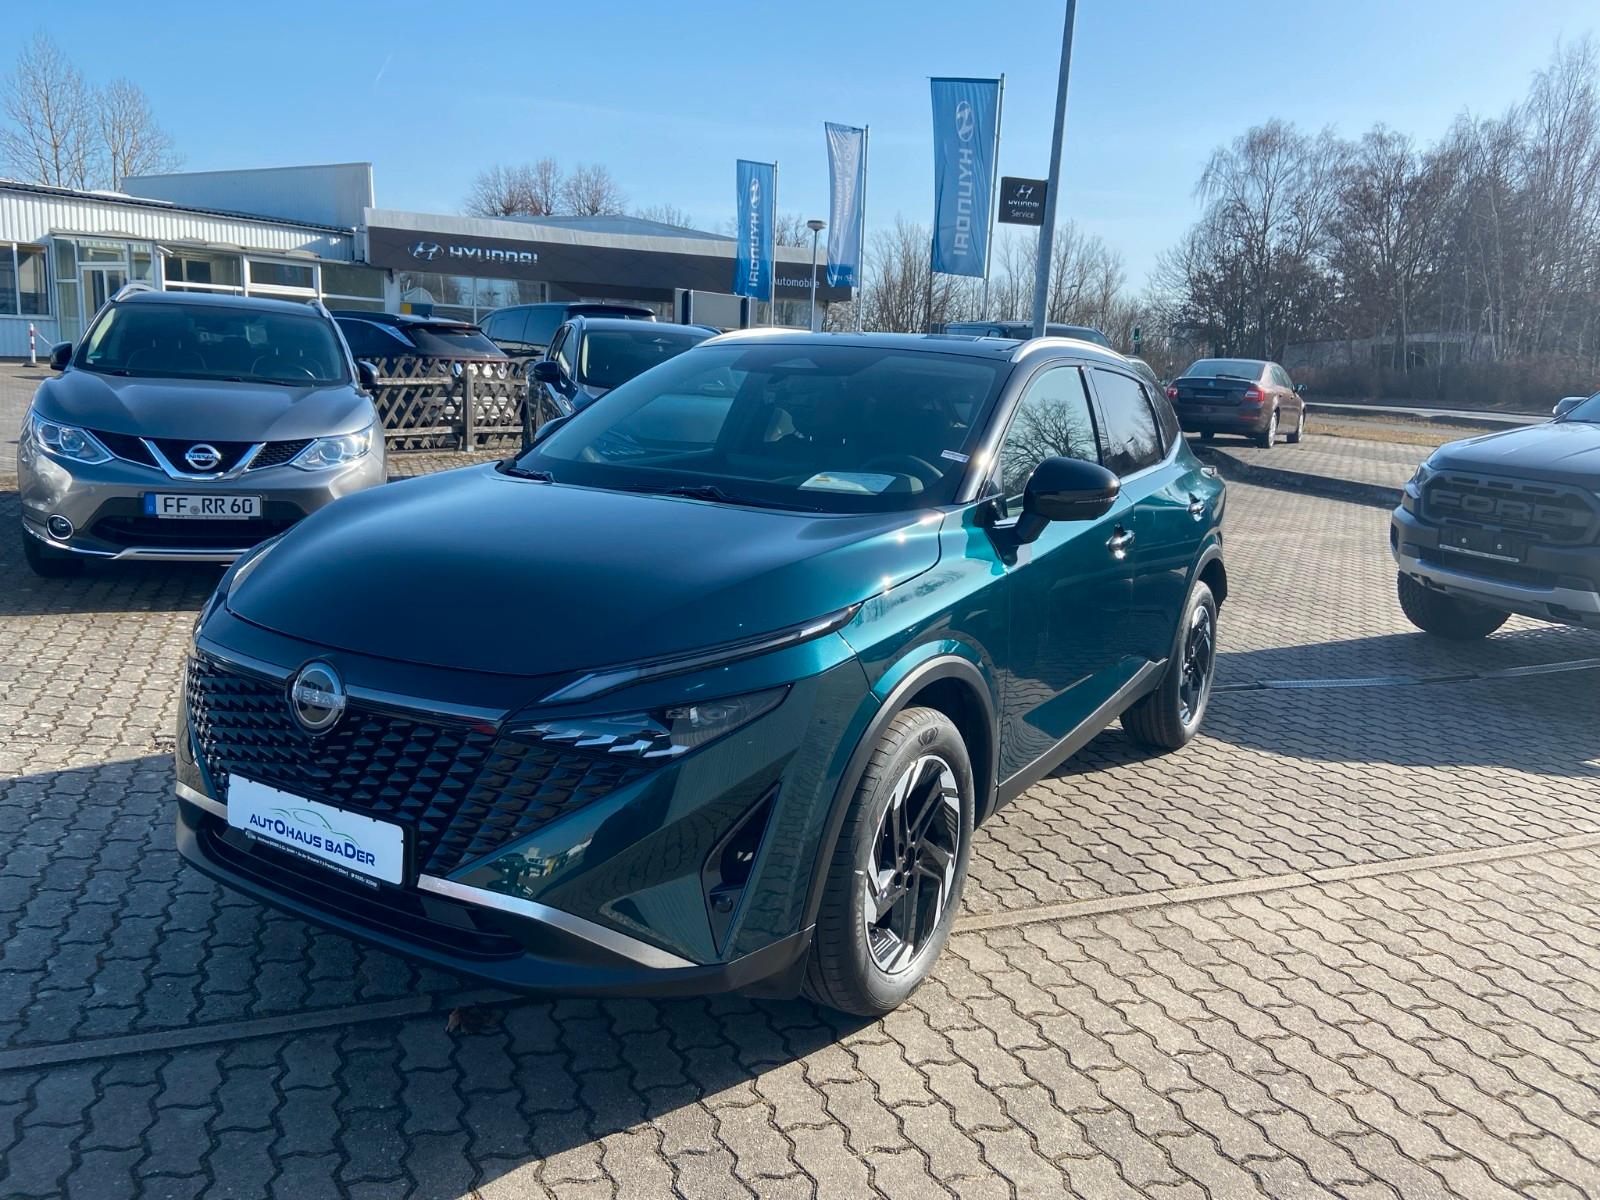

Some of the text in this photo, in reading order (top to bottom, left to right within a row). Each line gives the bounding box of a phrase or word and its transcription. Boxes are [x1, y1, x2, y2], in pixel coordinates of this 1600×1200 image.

[1011, 209, 1036, 219] Service
[449, 246, 538, 264] HYUNDAI
[772, 276, 820, 289] utomobie
[163, 496, 253, 514] FF RR 60
[1430, 489, 1592, 527] FORD
[249, 814, 322, 848] AUTOHAUS
[325, 839, 376, 867] BADER
